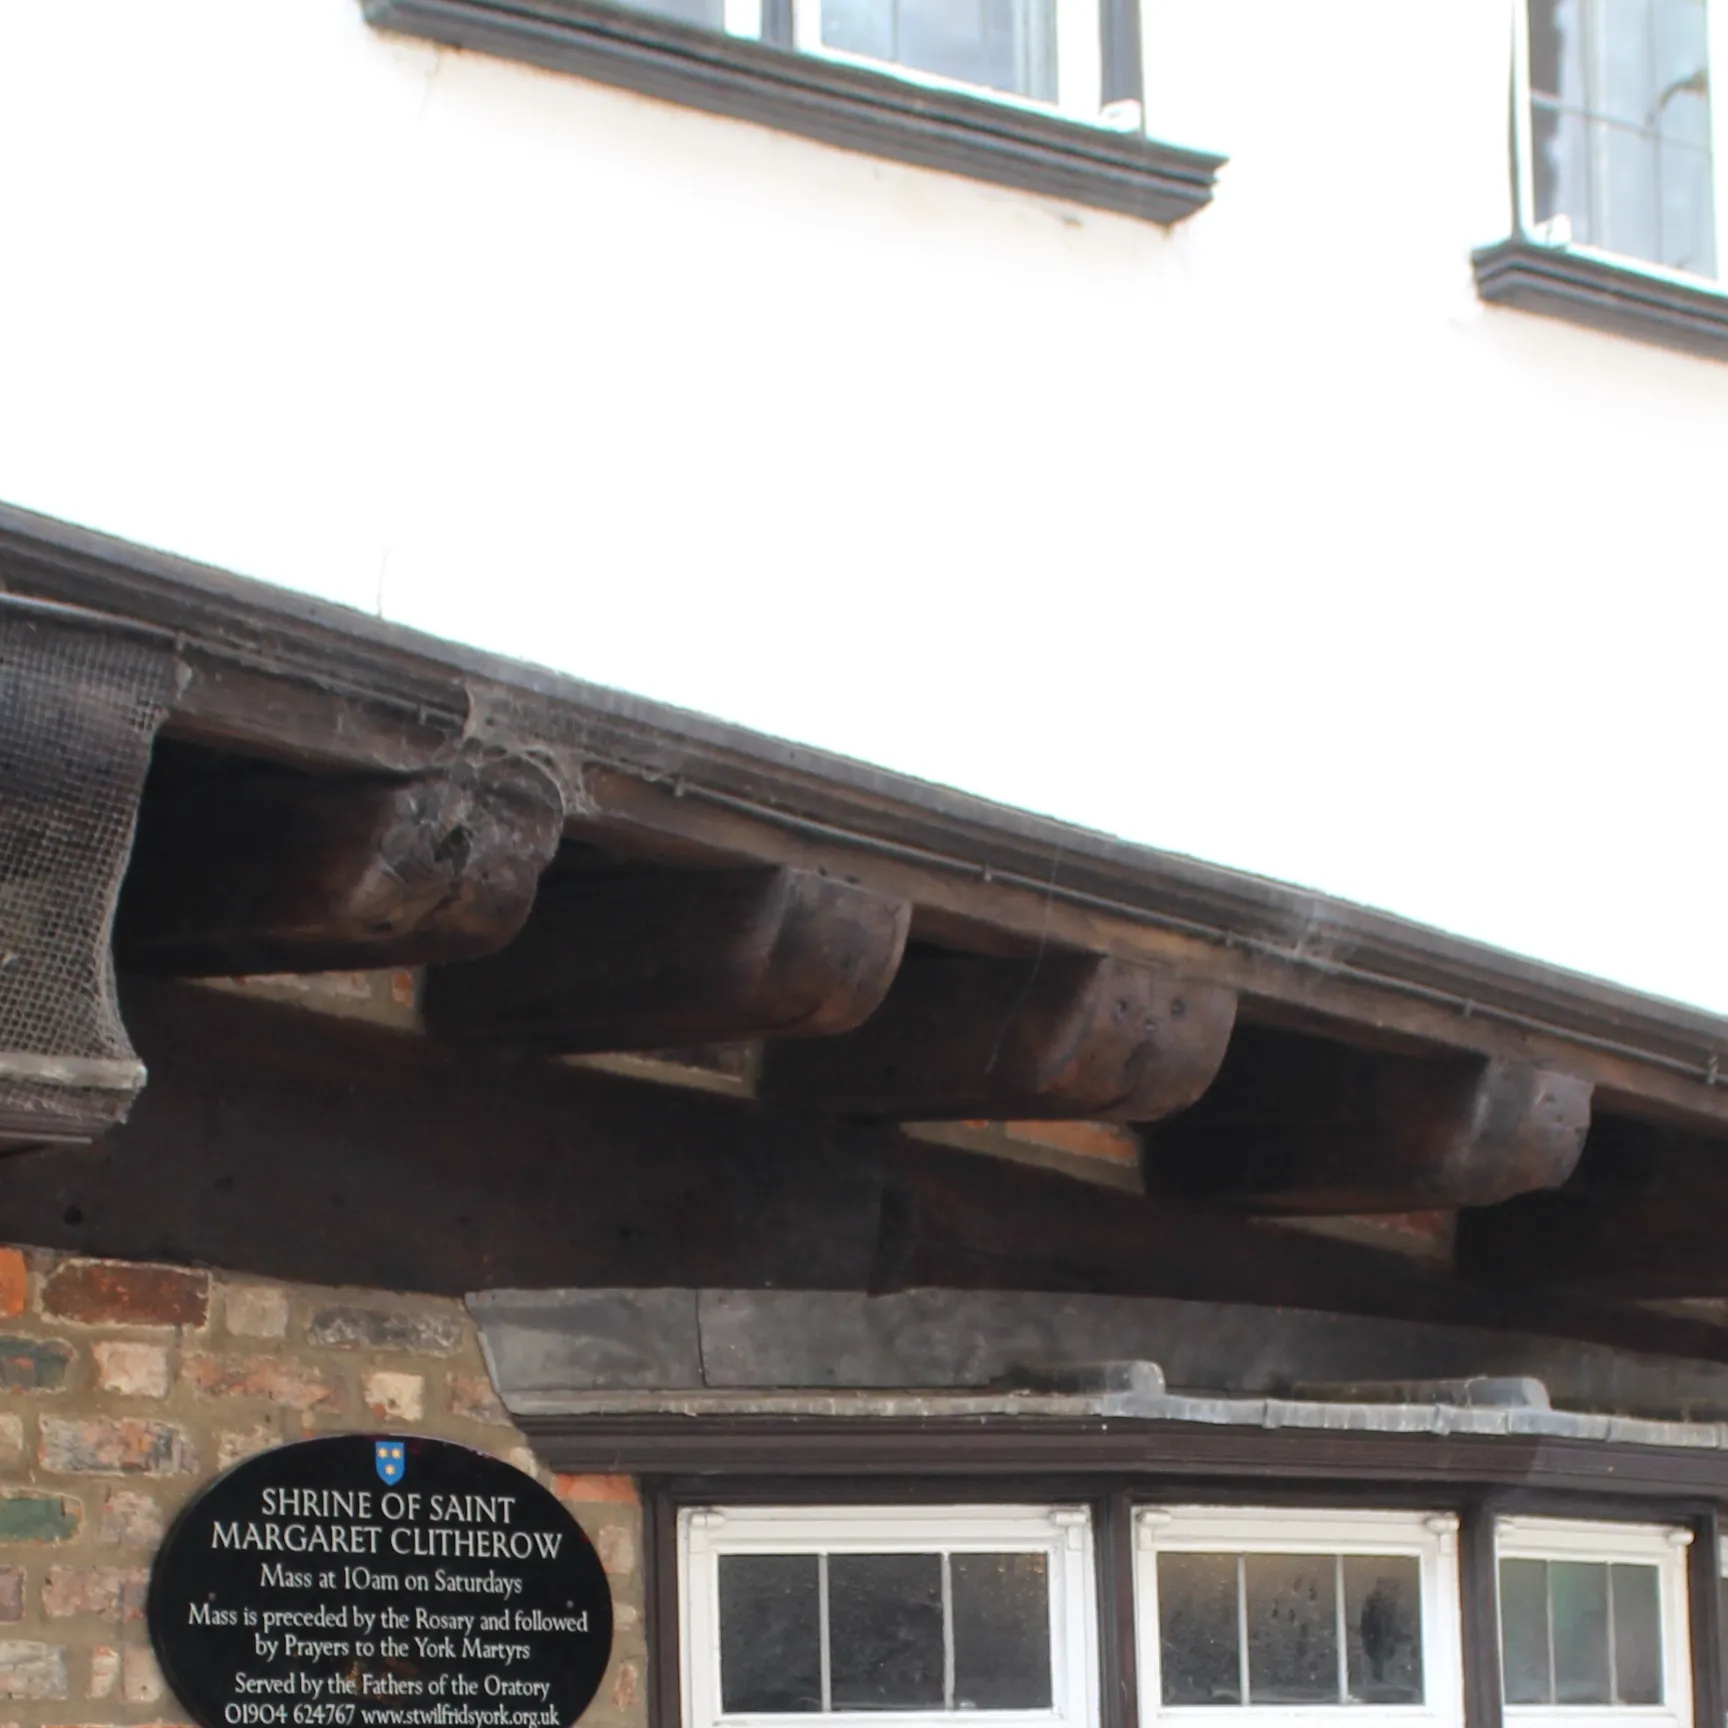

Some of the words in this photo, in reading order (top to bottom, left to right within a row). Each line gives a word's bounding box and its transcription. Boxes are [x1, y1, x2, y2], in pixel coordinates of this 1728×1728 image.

[261, 1487, 372, 1519] SHRINE
[381, 1492, 421, 1521] OF
[429, 1494, 516, 1524] SAINT
[211, 1521, 383, 1554] MARGARET
[390, 1527, 563, 1559] CLITHEROW
[260, 1562, 313, 1588] Mass
[319, 1571, 337, 1589] at
[344, 1566, 399, 1591] 10am
[404, 1575, 429, 1591] on
[434, 1568, 522, 1600] Saturdays
[188, 1602, 238, 1626] Mass
[243, 1607, 258, 1626] is
[262, 1603, 348, 1634] preceded
[352, 1605, 376, 1634] by
[380, 1606, 410, 1629] the
[415, 1607, 475, 1636] Rosary
[480, 1608, 510, 1631] and
[514, 1609, 589, 1632] followed
[254, 1632, 279, 1662] by
[284, 1633, 350, 1663] Prayers
[355, 1641, 375, 1657] to
[379, 1635, 409, 1658] the
[414, 1635, 457, 1658] York
[461, 1637, 530, 1665] Martyrs
[235, 1671, 296, 1694] Served
[299, 1671, 324, 1700] by
[327, 1670, 357, 1695] the
[362, 1672, 423, 1696] Fathers
[427, 1673, 449, 1695] of
[450, 1673, 479, 1696] the
[483, 1674, 550, 1701] Oratory
[224, 1702, 288, 1725] 01904
[293, 1703, 356, 1725] 624767
